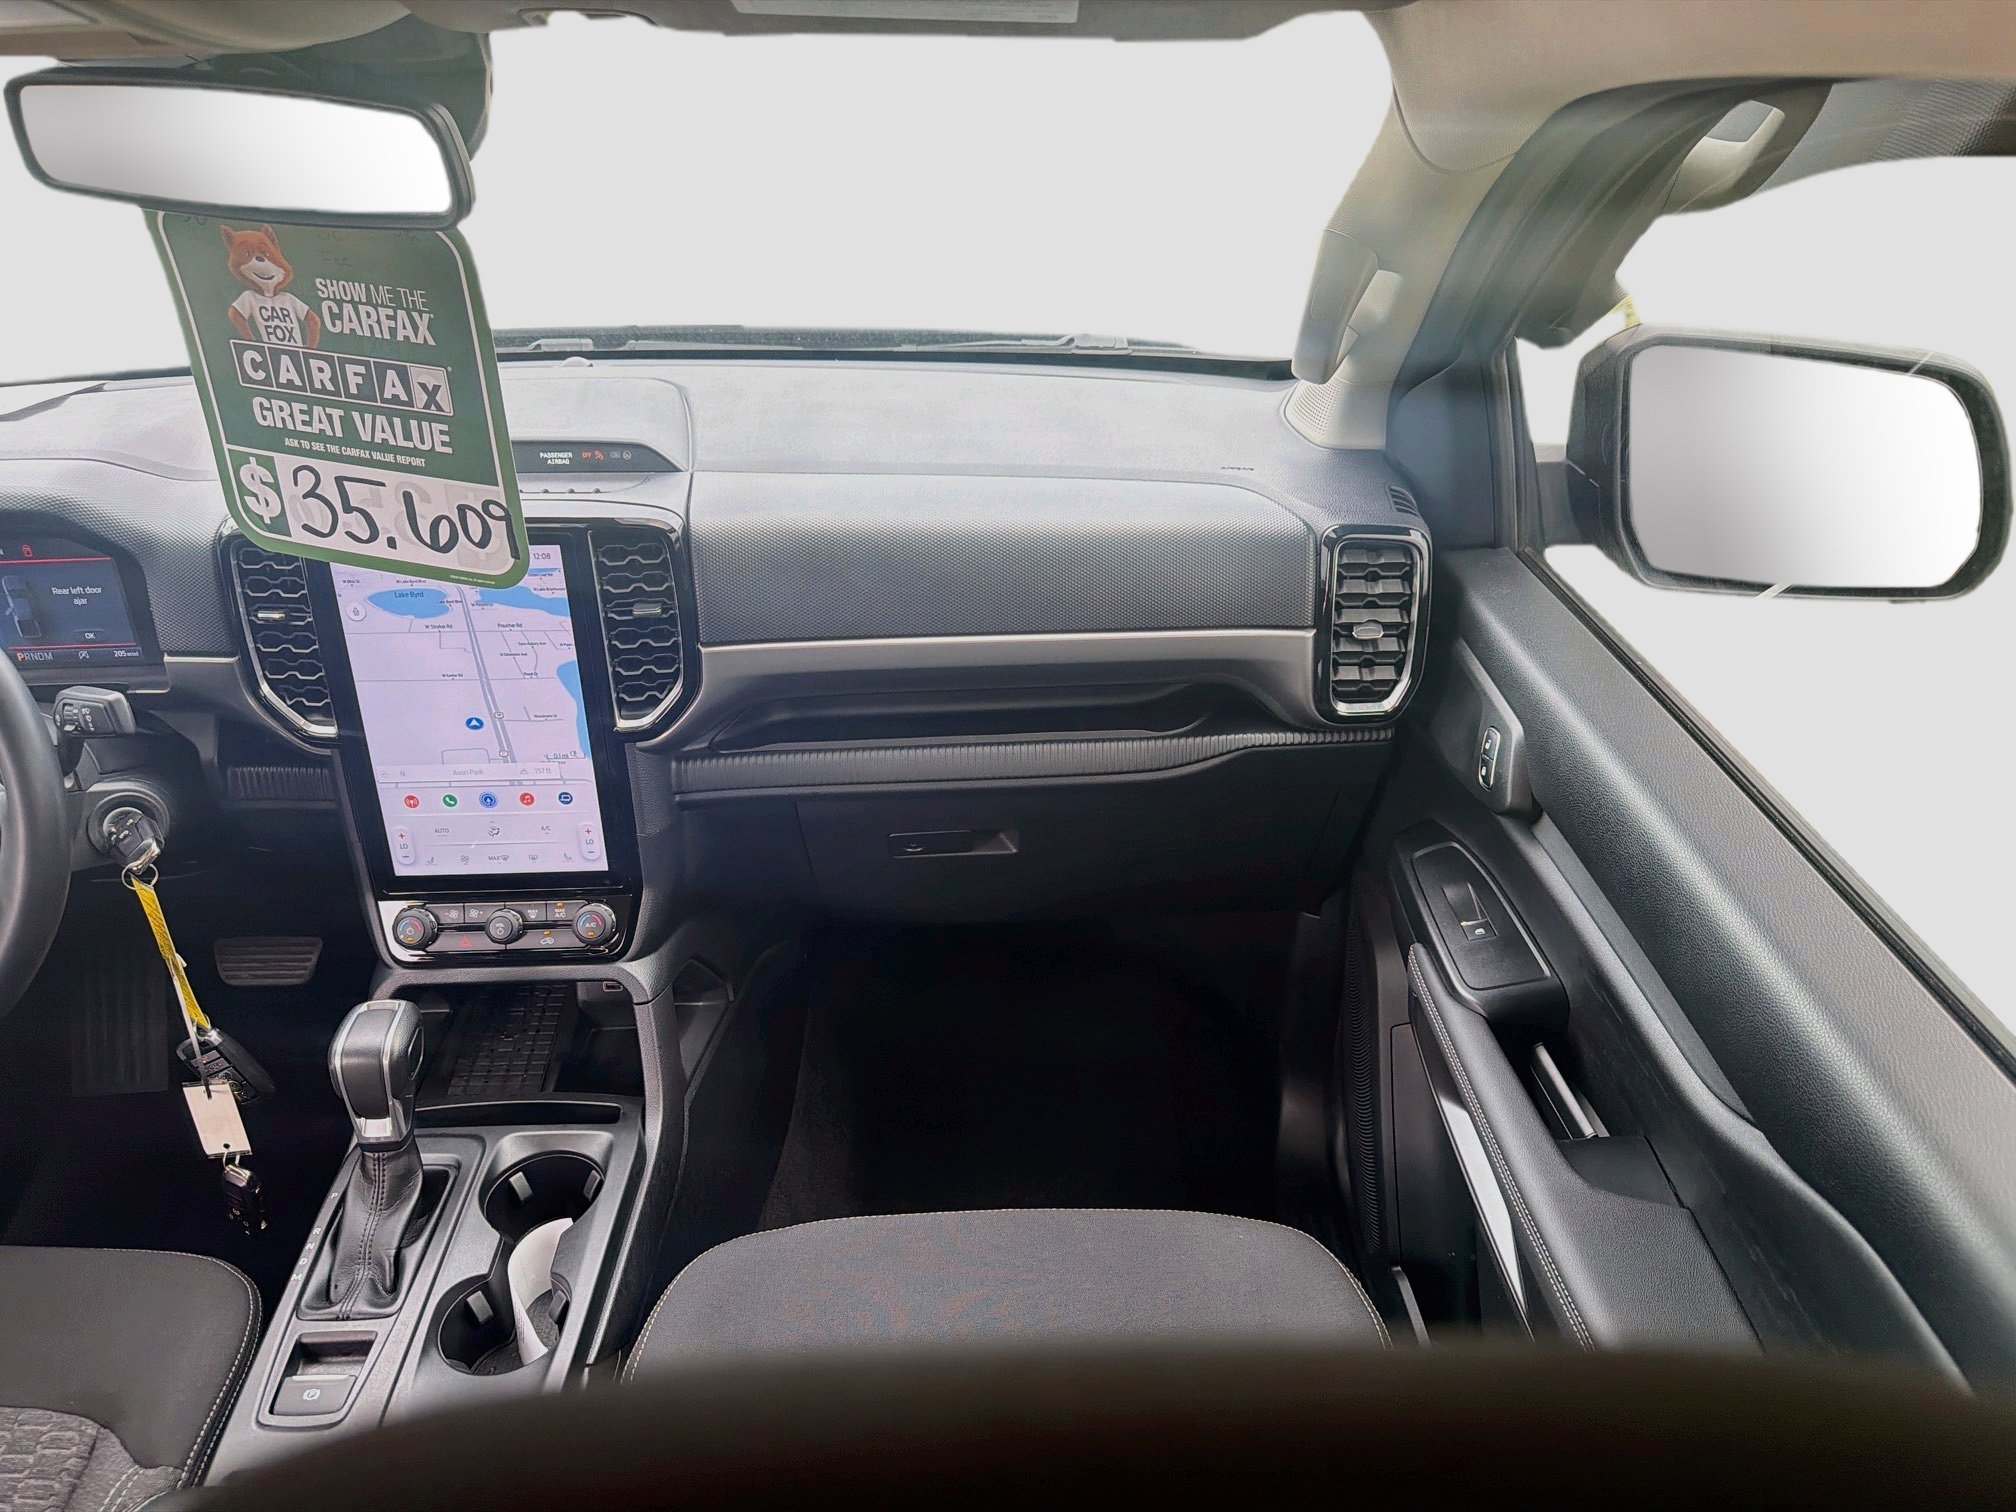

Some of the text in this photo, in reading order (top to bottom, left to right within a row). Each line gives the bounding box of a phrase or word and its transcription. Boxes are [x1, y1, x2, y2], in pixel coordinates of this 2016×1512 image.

[316, 278, 430, 312] SHOW ME THE
[259, 305, 293, 325] CAR
[321, 300, 436, 347] CARFAX
[264, 325, 297, 344] FOX
[241, 348, 444, 413] CARFAX
[252, 397, 454, 454] GREAT VALUE
[284, 437, 426, 468] ASK TO SEE THE CARFAX VALUE REPORT
[539, 451, 573, 459] PASSENGER
[533, 552, 552, 560] 12:08
[52, 586, 102, 595] Rear left door
[394, 591, 424, 599] Lake Byrd
[73, 596, 88, 606] ajar
[84, 632, 96, 640] OK
[113, 650, 127, 658] 205
[586, 838, 595, 846] LO
[313, 1227, 321, 1235] R
[291, 1273, 302, 1281] M
